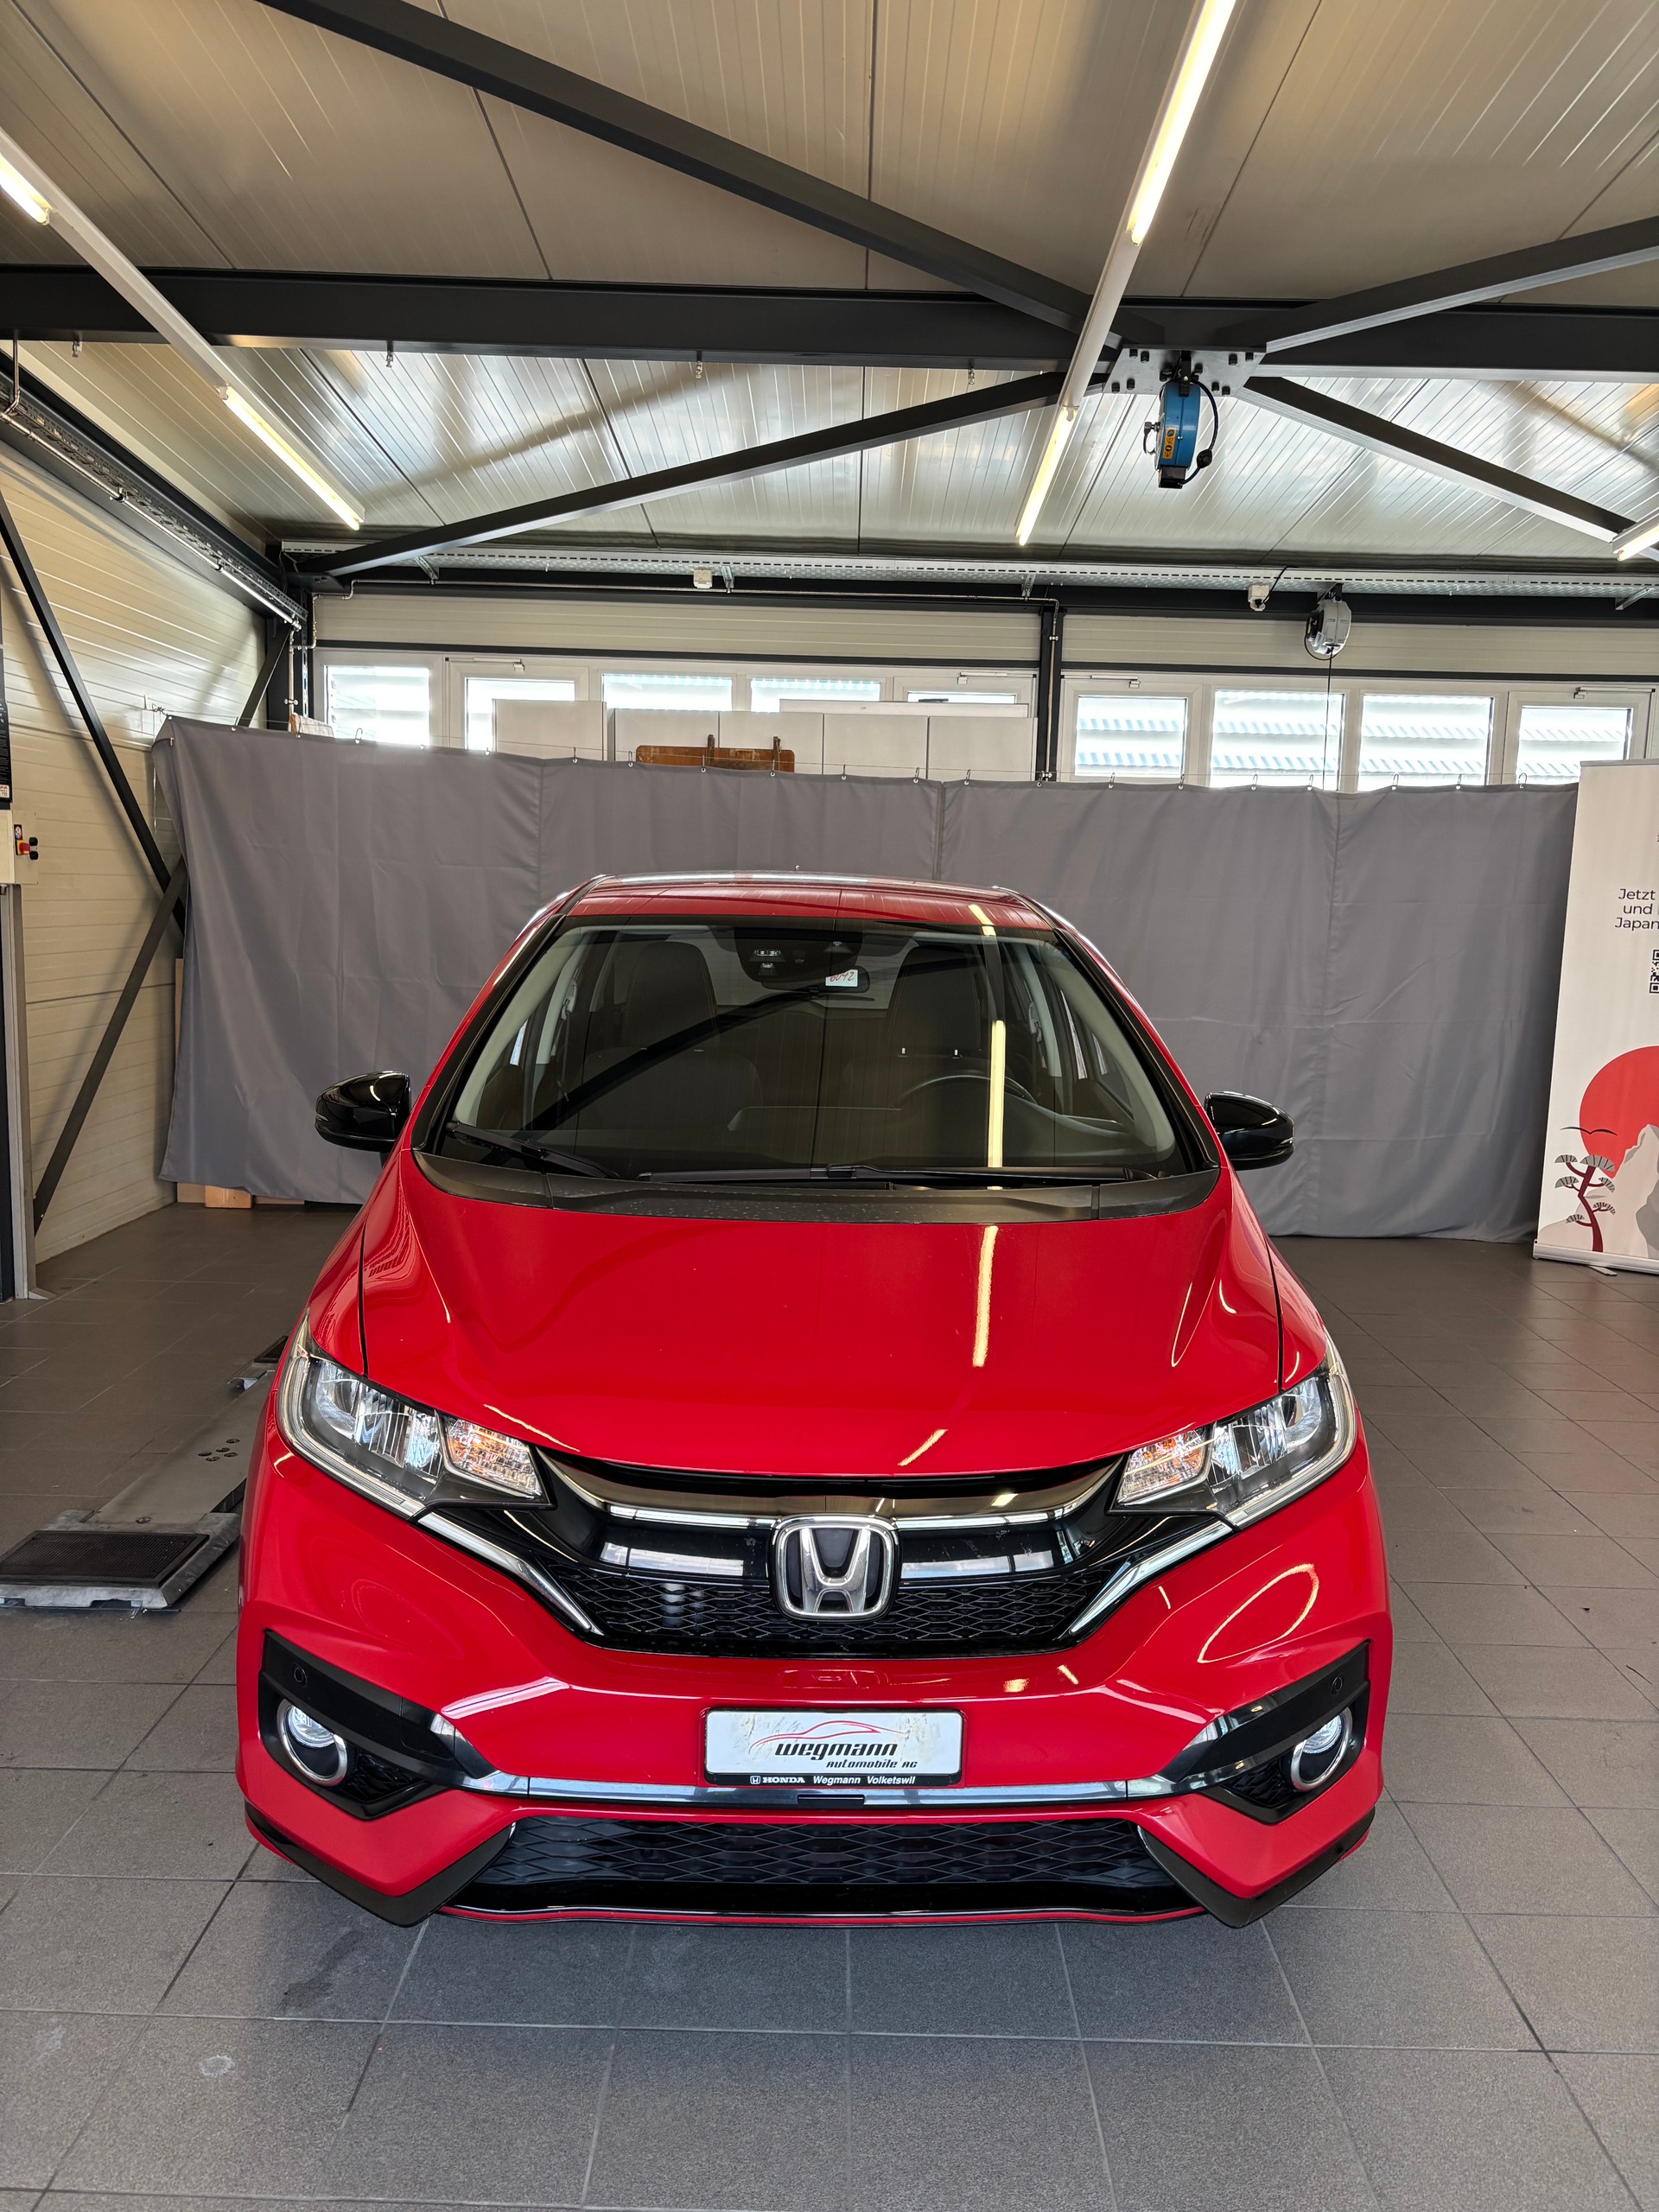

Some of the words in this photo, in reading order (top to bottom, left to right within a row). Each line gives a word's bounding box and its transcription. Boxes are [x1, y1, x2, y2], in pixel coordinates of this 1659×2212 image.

[1618, 887, 1656, 900] Jetzt
[1623, 903, 1653, 915] und
[774, 1743, 899, 1761] wegmann
[813, 1776, 861, 1786] Wegmann
[867, 1776, 916, 1785] Volketswil
